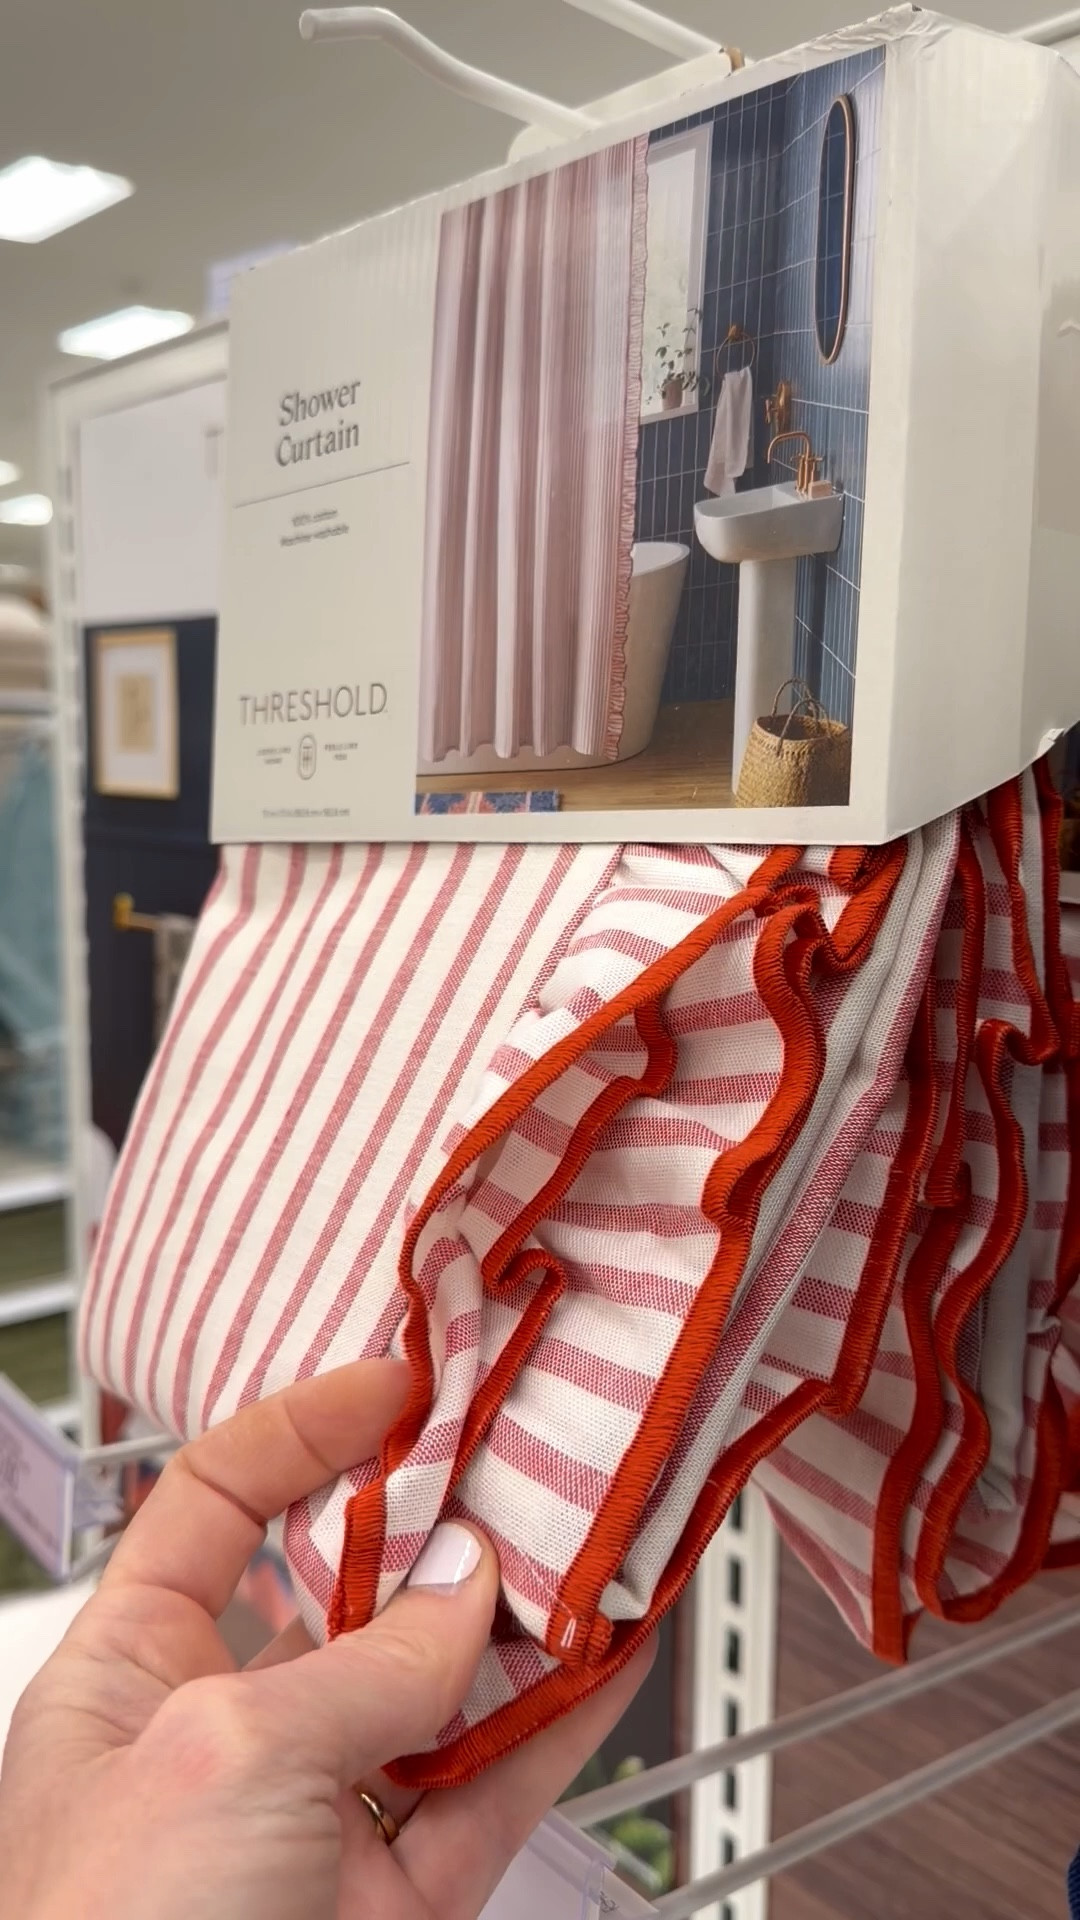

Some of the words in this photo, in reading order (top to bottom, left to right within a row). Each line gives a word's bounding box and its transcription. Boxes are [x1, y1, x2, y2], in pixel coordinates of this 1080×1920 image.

[279, 381, 361, 426] Shower
[275, 419, 360, 467] Curtain
[239, 682, 388, 726] THRESHOLD
